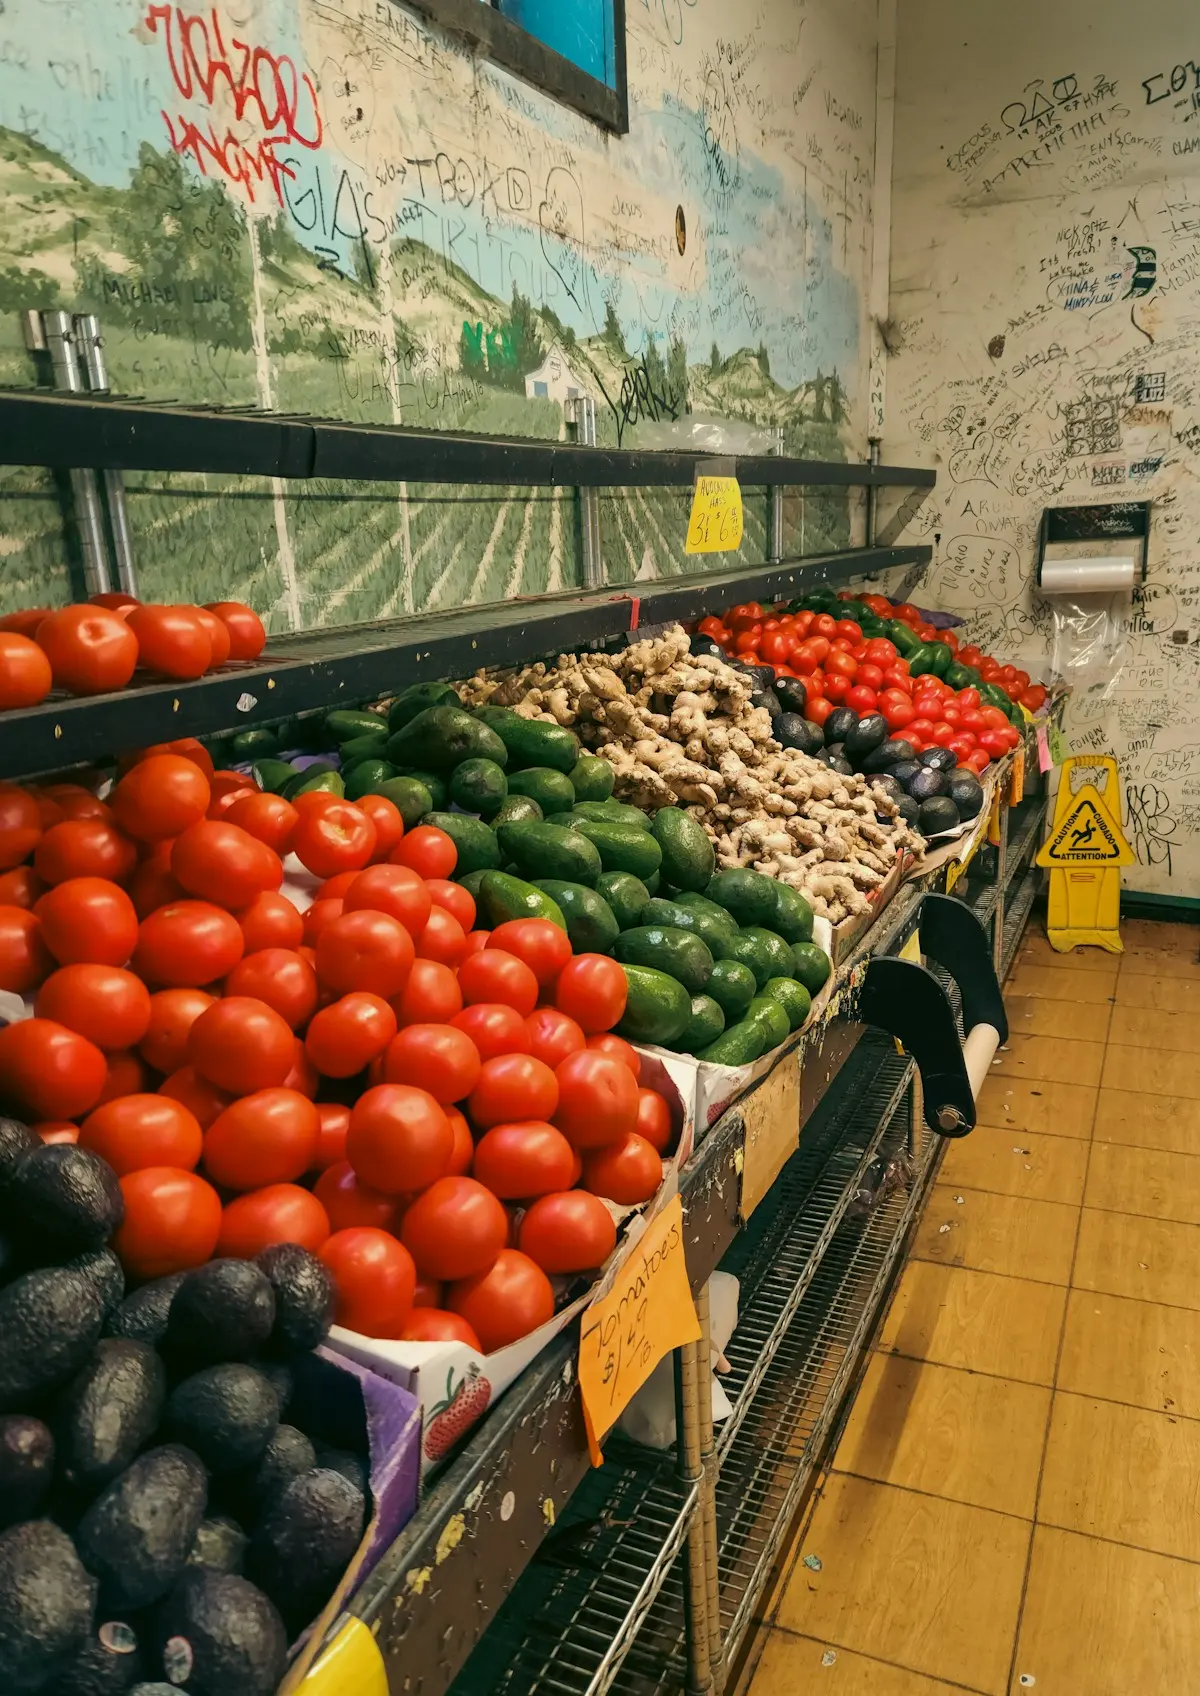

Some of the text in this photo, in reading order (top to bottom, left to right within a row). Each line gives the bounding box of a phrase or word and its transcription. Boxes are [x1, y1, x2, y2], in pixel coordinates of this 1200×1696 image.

[1054, 812, 1079, 846] CAUTION
[1093, 812, 1116, 846] CUIDADO
[1060, 852, 1107, 861] ATTENTION
